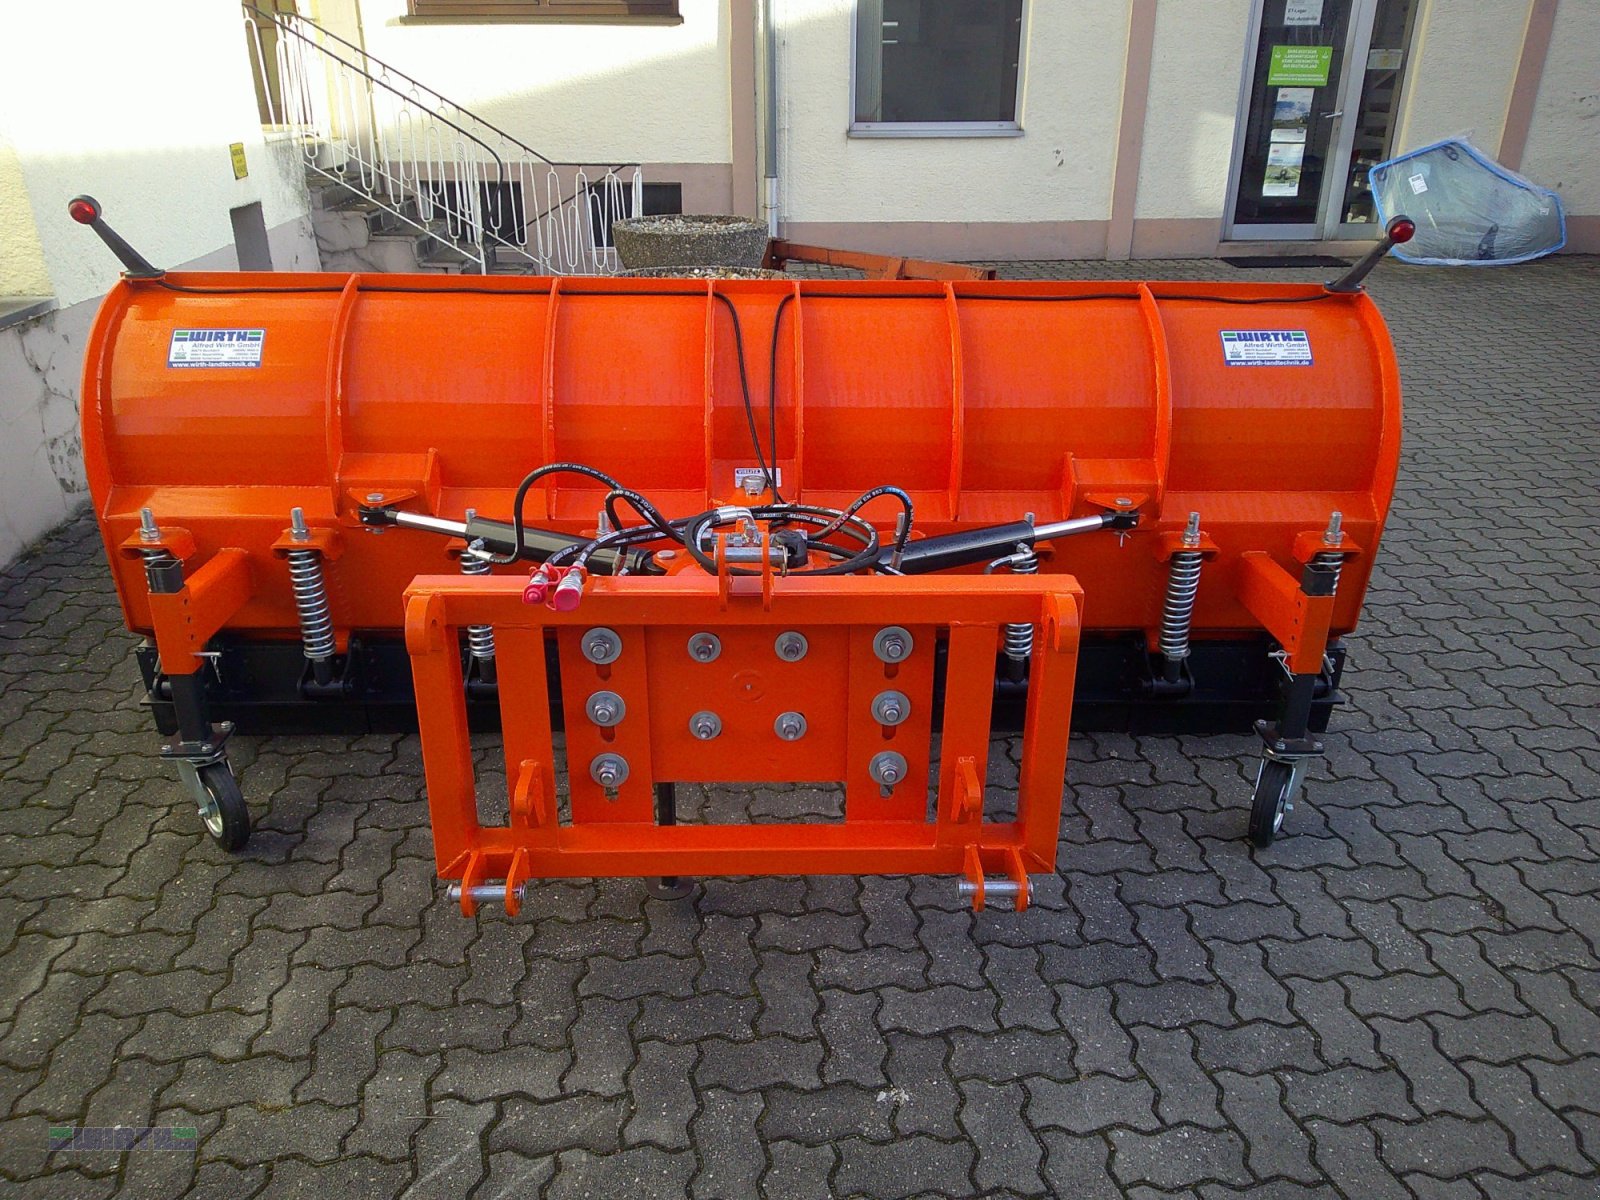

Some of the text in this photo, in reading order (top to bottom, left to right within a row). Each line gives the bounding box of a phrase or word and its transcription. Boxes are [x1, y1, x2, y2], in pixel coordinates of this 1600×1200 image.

[188, 331, 248, 342] WIRTH
[1236, 332, 1293, 341] WIRTH
[624, 491, 640, 501] BAR
